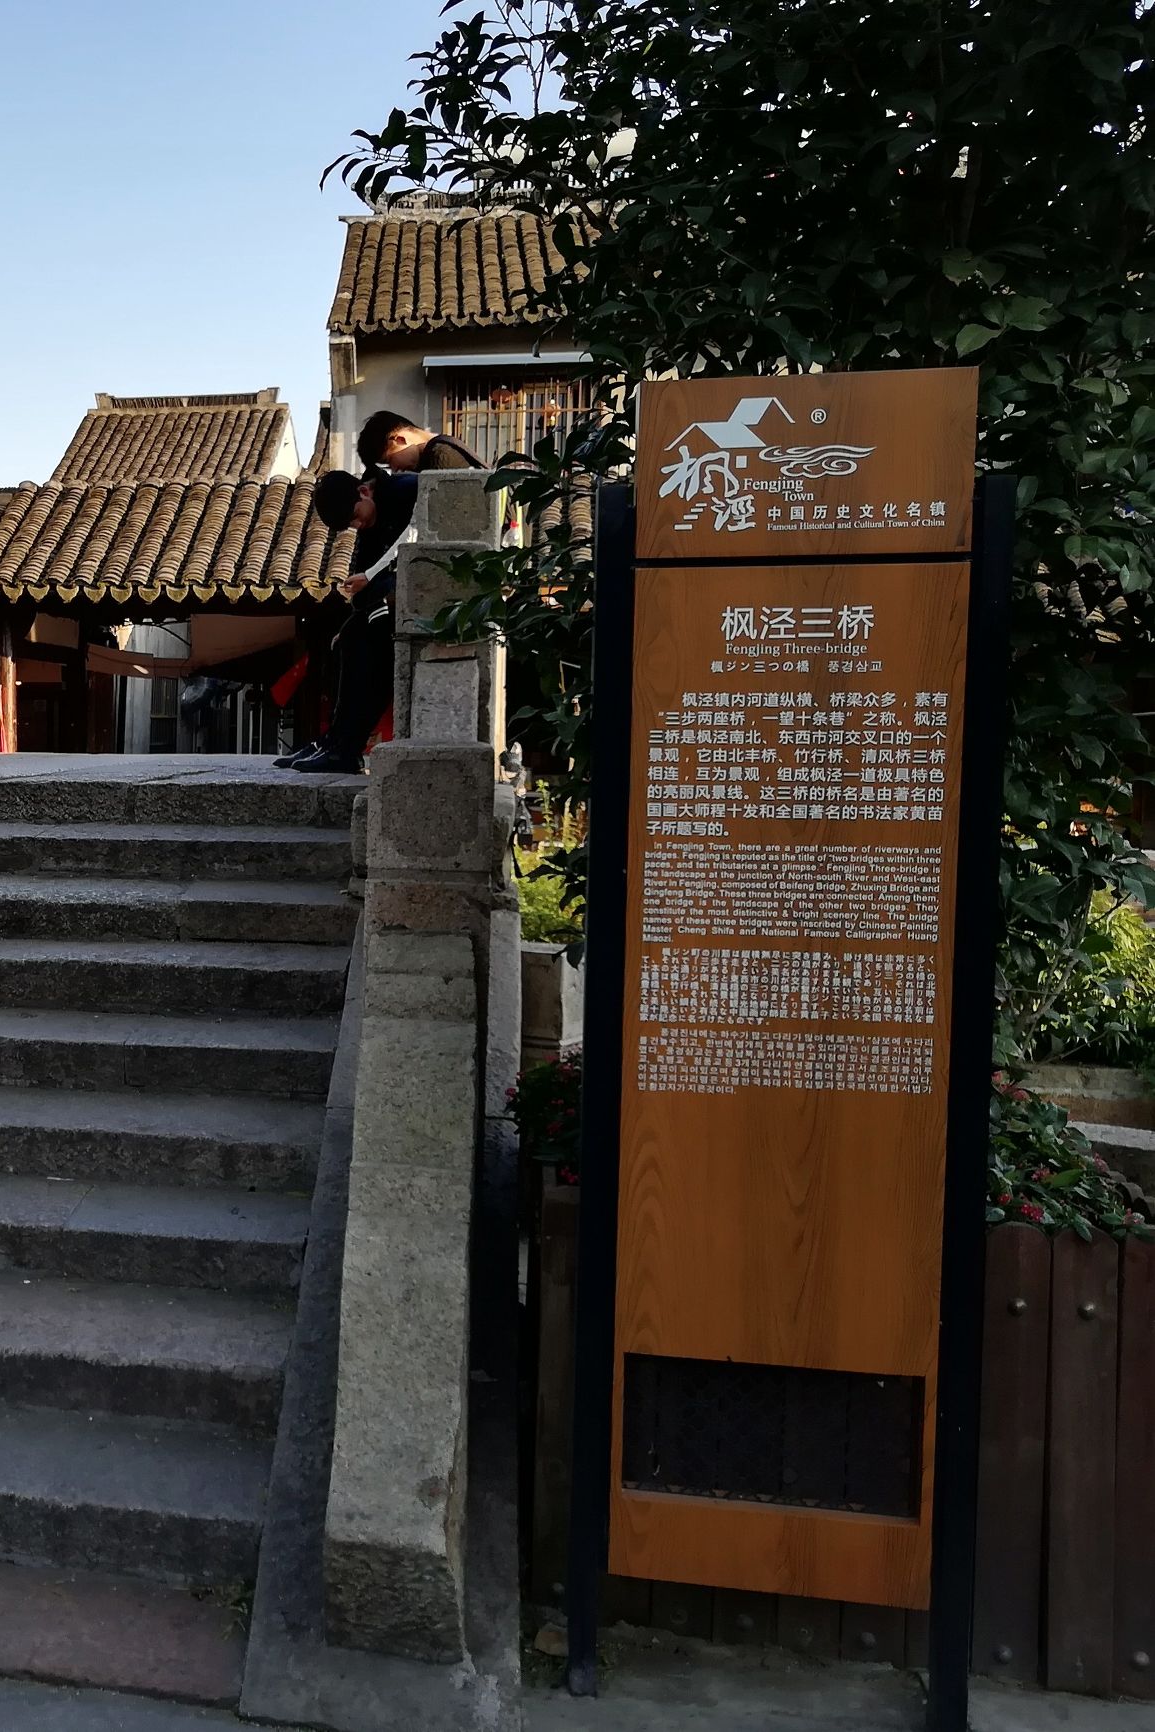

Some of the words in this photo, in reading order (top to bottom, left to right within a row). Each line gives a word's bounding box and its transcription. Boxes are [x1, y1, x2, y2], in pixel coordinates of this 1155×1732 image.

[742, 477, 803, 493] Fengjing
[781, 489, 813, 501] Town
[767, 522, 797, 530] Famous
[799, 521, 834, 529] Historical
[837, 520, 851, 528] and
[853, 520, 884, 528] Cultural
[885, 519, 908, 527] Town
[909, 518, 920, 526] of
[921, 518, 944, 526] China
[720, 604, 874, 640] 枫泾三桥
[725, 643, 780, 657] Fengjing
[782, 642, 867, 656] Three-bridge
[666, 842, 704, 851] Fengjing
[738, 843, 761, 851] there
[794, 844, 818, 853] great
[822, 844, 857, 852] number
[861, 845, 870, 853] of
[874, 846, 919, 855] riverways
[682, 851, 720, 861] Fengjing
[722, 852, 730, 860] is
[732, 853, 766, 861] reputed
[781, 853, 795, 861] the
[798, 853, 814, 861] title
[817, 853, 826, 861] of
[850, 854, 884, 864] bridges
[886, 855, 914, 863] within
[916, 855, 940, 863] three
[676, 860, 693, 868] and
[712, 861, 757, 869] tributaries
[760, 862, 769, 870] at
[826, 863, 865, 873] Fengjing
[869, 864, 928, 874] Three-bridge
[644, 869, 658, 877] the
[661, 869, 705, 879] landscape
[737, 871, 772, 880] junction
[788, 872, 841, 881] North-south
[844, 873, 869, 881] River
[872, 873, 889, 882] and
[643, 878, 667, 886] River
[721, 880, 767, 889] composed
[768, 881, 778, 889] of
[850, 883, 887, 892] Zhuxing
[889, 883, 920, 892] Bridge
[922, 884, 939, 892] and
[719, 889, 746, 897] These
[748, 890, 771, 898] three
[773, 890, 806, 899] bridges
[878, 892, 910, 902] Among
[665, 897, 693, 906] bridge
[699, 898, 706, 906] is
[732, 899, 778, 908] landscape
[784, 900, 793, 908] of
[798, 900, 813, 908] the
[818, 901, 843, 909] other
[849, 902, 865, 910] two
[915, 903, 939, 912] They
[707, 908, 729, 916] most
[732, 908, 777, 917] distinctive
[781, 909, 788, 917] &
[792, 910, 818, 919] bright
[823, 912, 858, 920] scenery
[887, 912, 904, 920] The
[909, 913, 938, 922] bridge
[686, 916, 710, 924] these
[713, 917, 736, 925] three
[739, 918, 772, 927] bridges
[800, 919, 841, 928] inscribed
[844, 920, 855, 929] by
[858, 920, 896, 929] Chinese
[900, 922, 938, 931] Painting
[642, 924, 672, 933] Master
[677, 925, 706, 935] Cheng
[739, 927, 756, 935] and
[761, 927, 798, 936] National
[804, 928, 840, 937] Famous
[845, 930, 902, 940] Calligrapher
[907, 931, 937, 941] Huang
